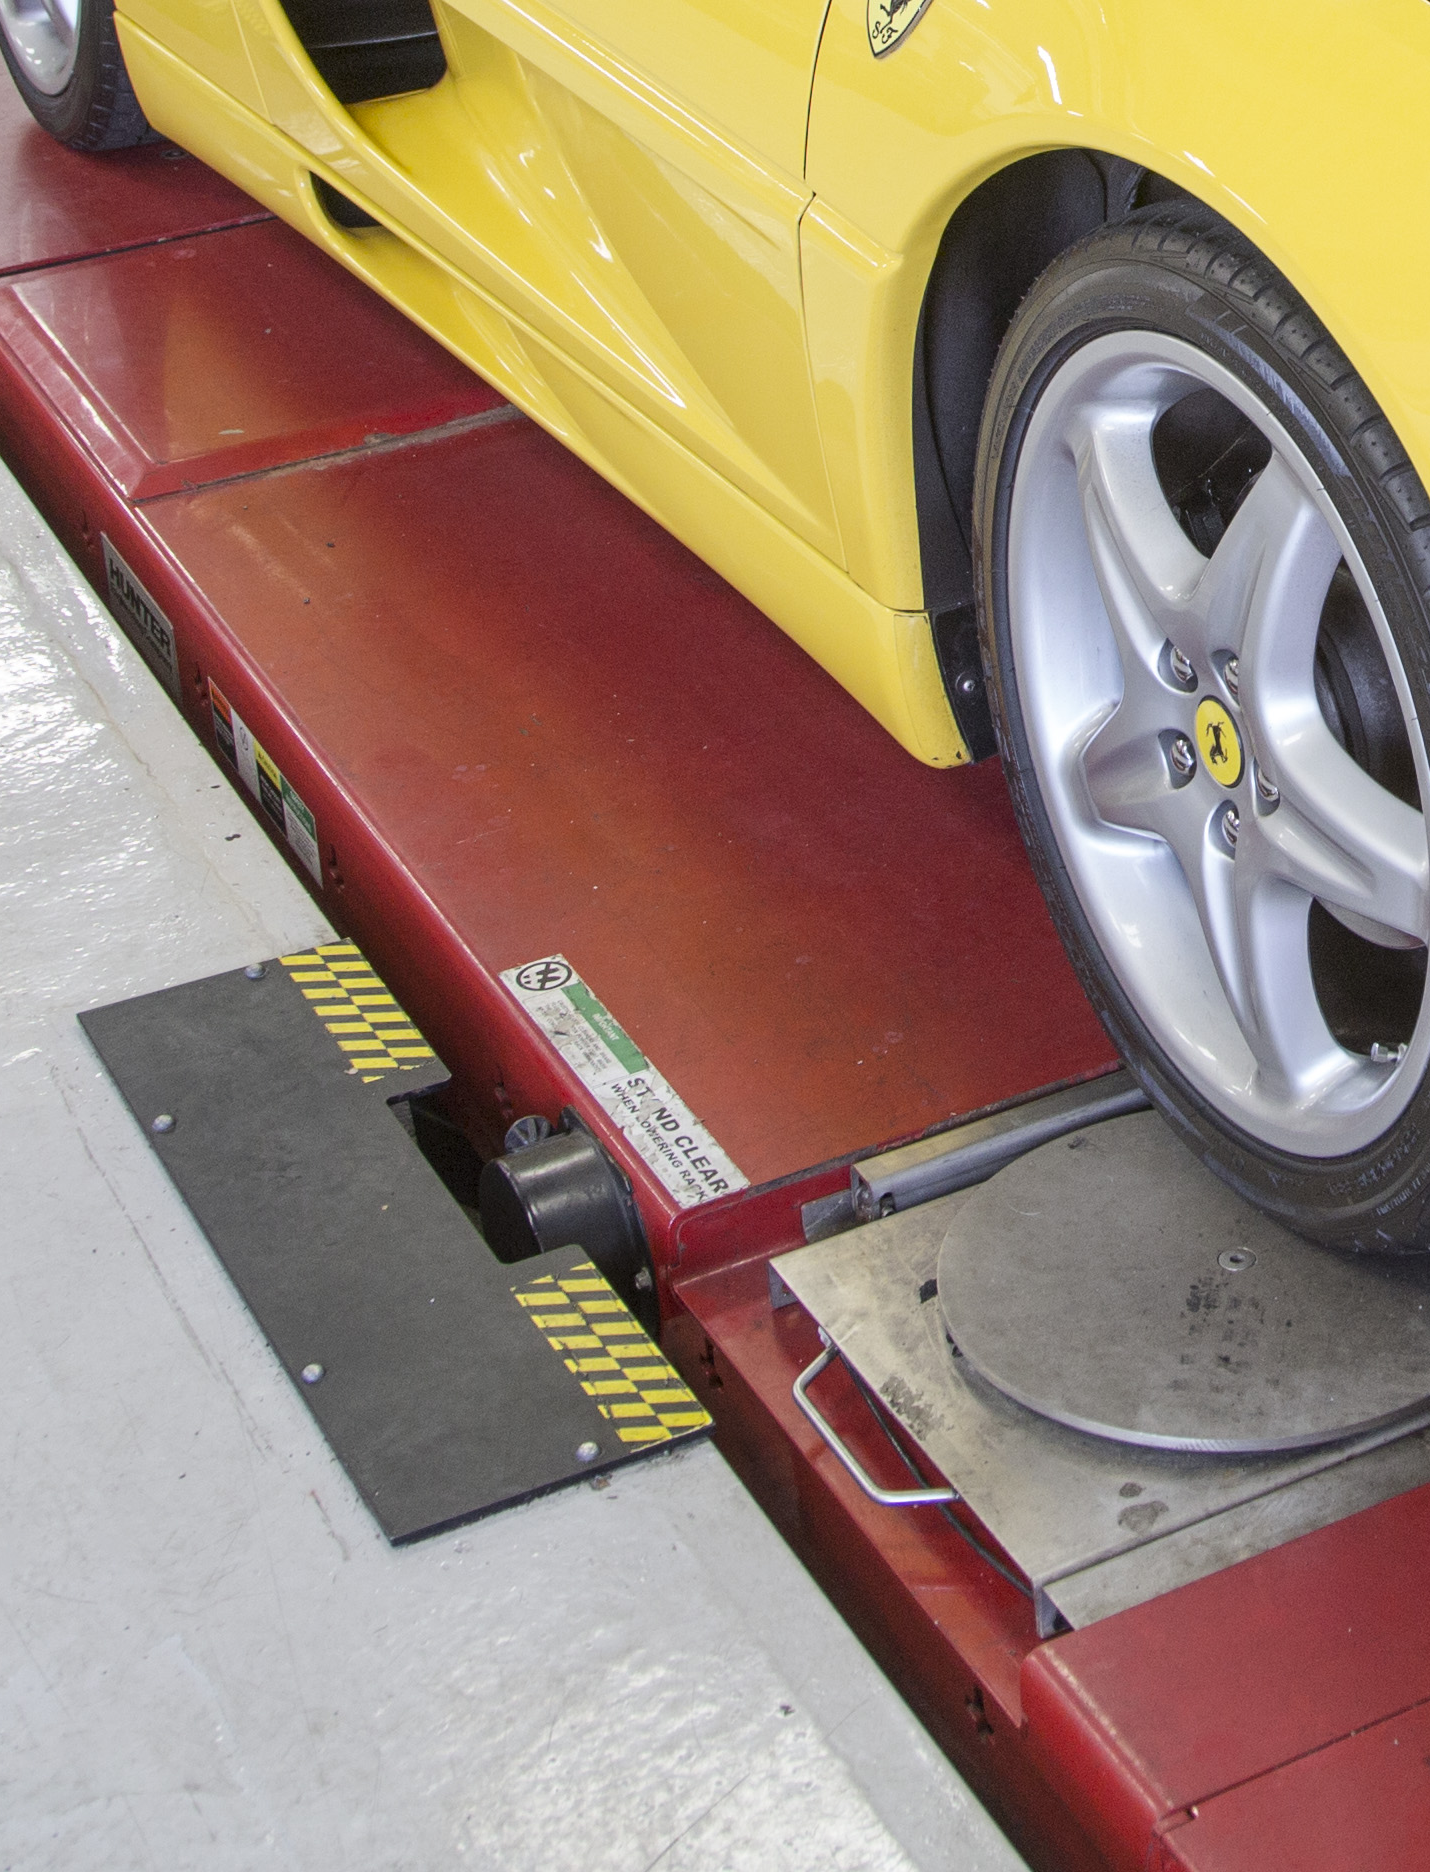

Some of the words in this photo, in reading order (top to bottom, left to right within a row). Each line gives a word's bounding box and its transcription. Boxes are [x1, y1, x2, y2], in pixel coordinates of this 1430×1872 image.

[108, 557, 172, 649] HUNTER
[611, 1083, 640, 1114] WHEN
[627, 1077, 680, 1132] STND
[674, 1135, 729, 1194] CLEAR
